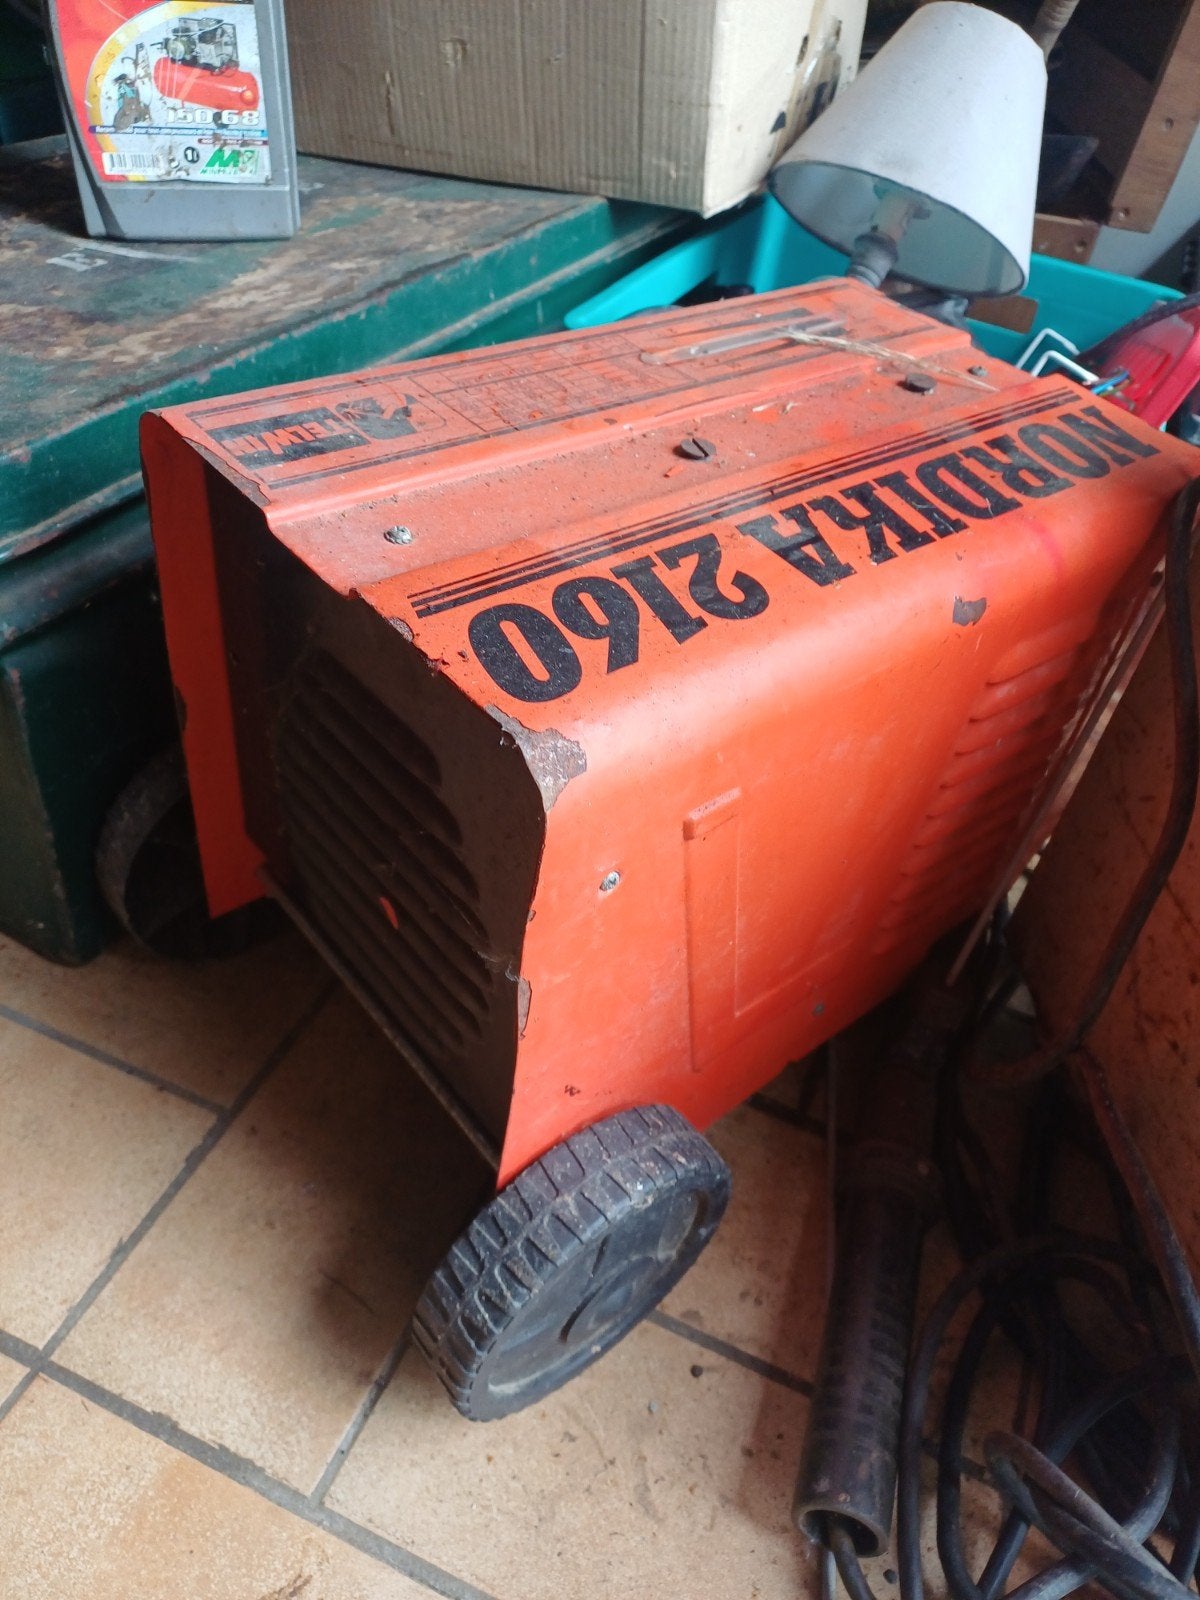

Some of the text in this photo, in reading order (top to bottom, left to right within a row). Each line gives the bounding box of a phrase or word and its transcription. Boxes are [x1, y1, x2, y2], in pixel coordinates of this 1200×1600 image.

[221, 109, 260, 126] 68
[220, 418, 353, 456] TELWIN
[466, 405, 1160, 703] NORDIKA 2160
